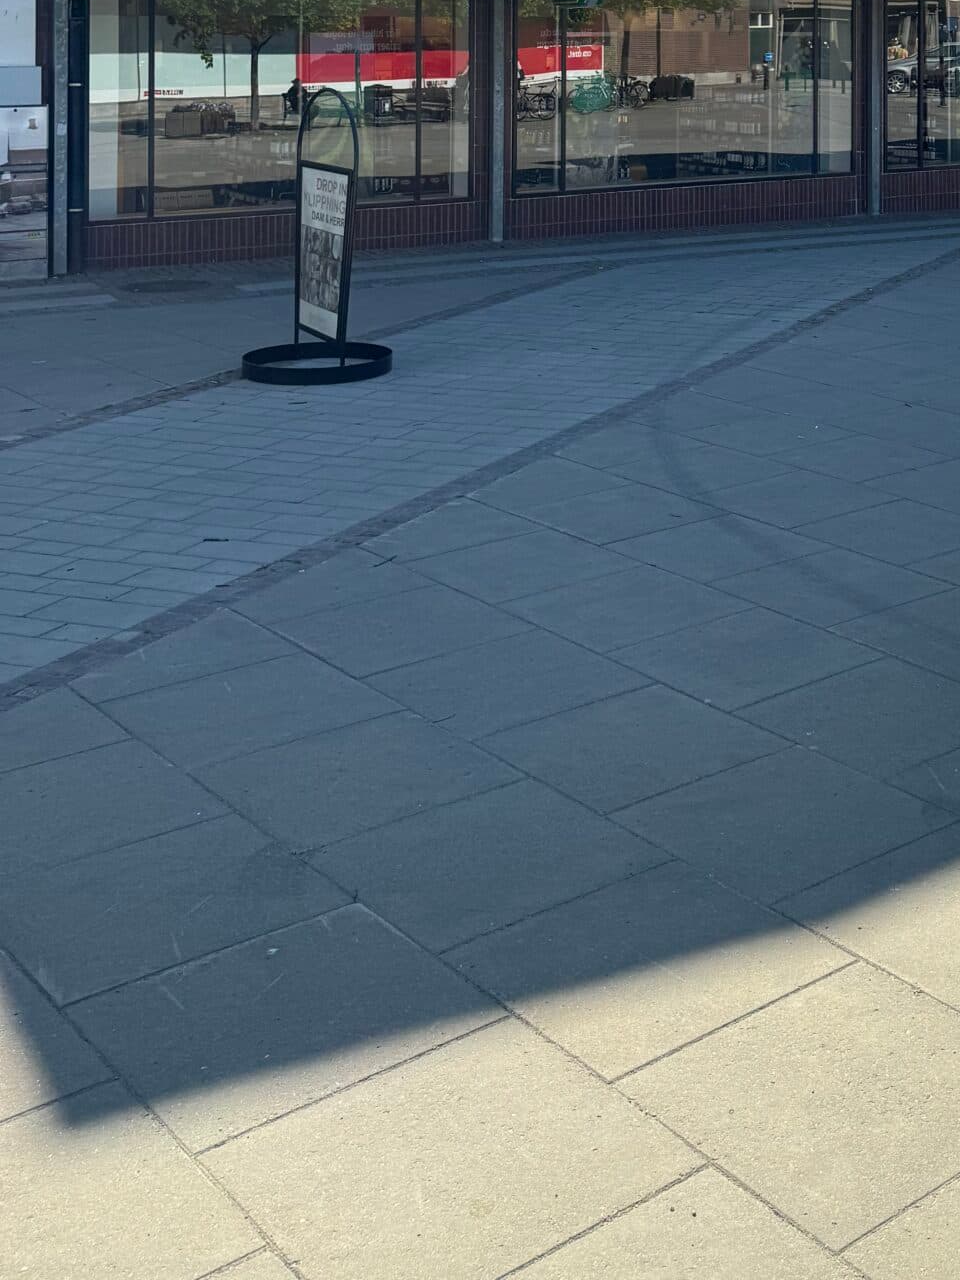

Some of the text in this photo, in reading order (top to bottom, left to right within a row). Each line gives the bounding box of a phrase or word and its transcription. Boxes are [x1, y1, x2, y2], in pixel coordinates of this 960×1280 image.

[316, 178, 347, 197] DROP IN
[303, 191, 346, 215] KLIPPNING
[311, 210, 325, 222] DAM
